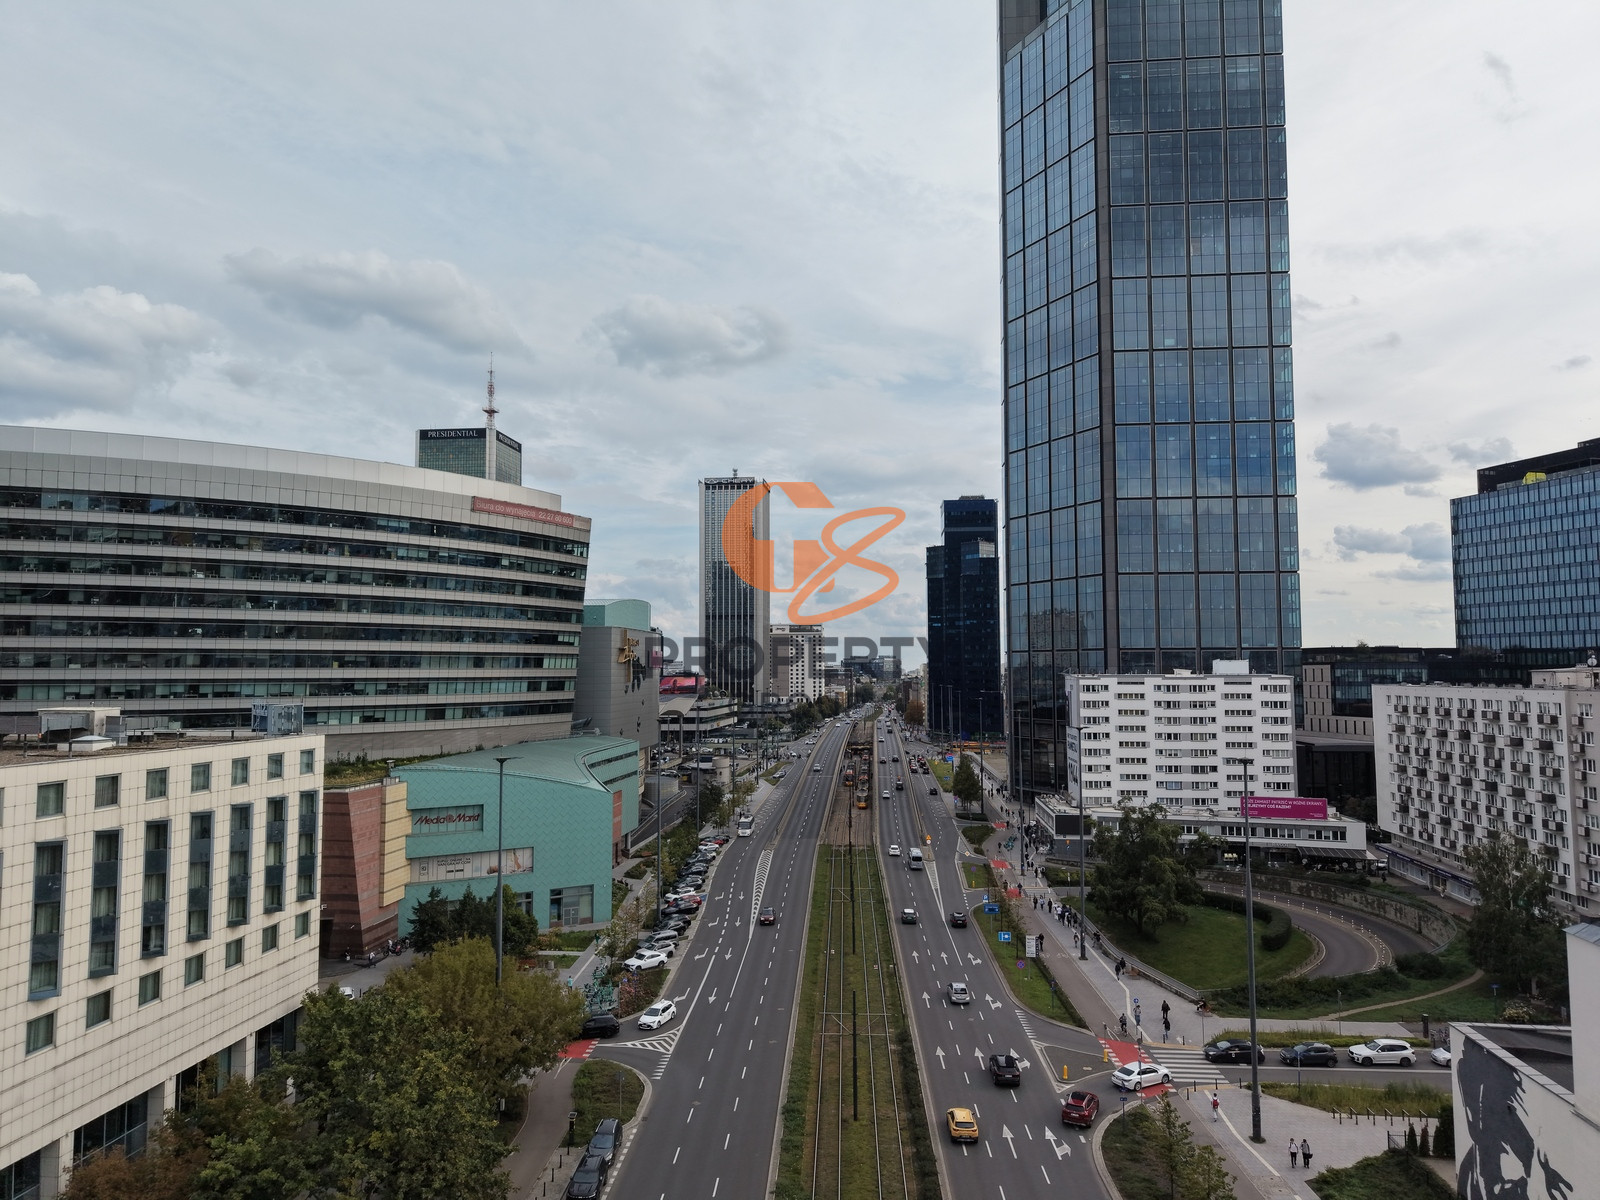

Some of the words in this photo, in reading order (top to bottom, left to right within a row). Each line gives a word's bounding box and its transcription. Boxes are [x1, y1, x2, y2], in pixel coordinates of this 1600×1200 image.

[427, 430, 478, 438] PRESIDENTIAL
[476, 500, 494, 510] Biura
[495, 504, 504, 512] do
[414, 815, 447, 826] Media
